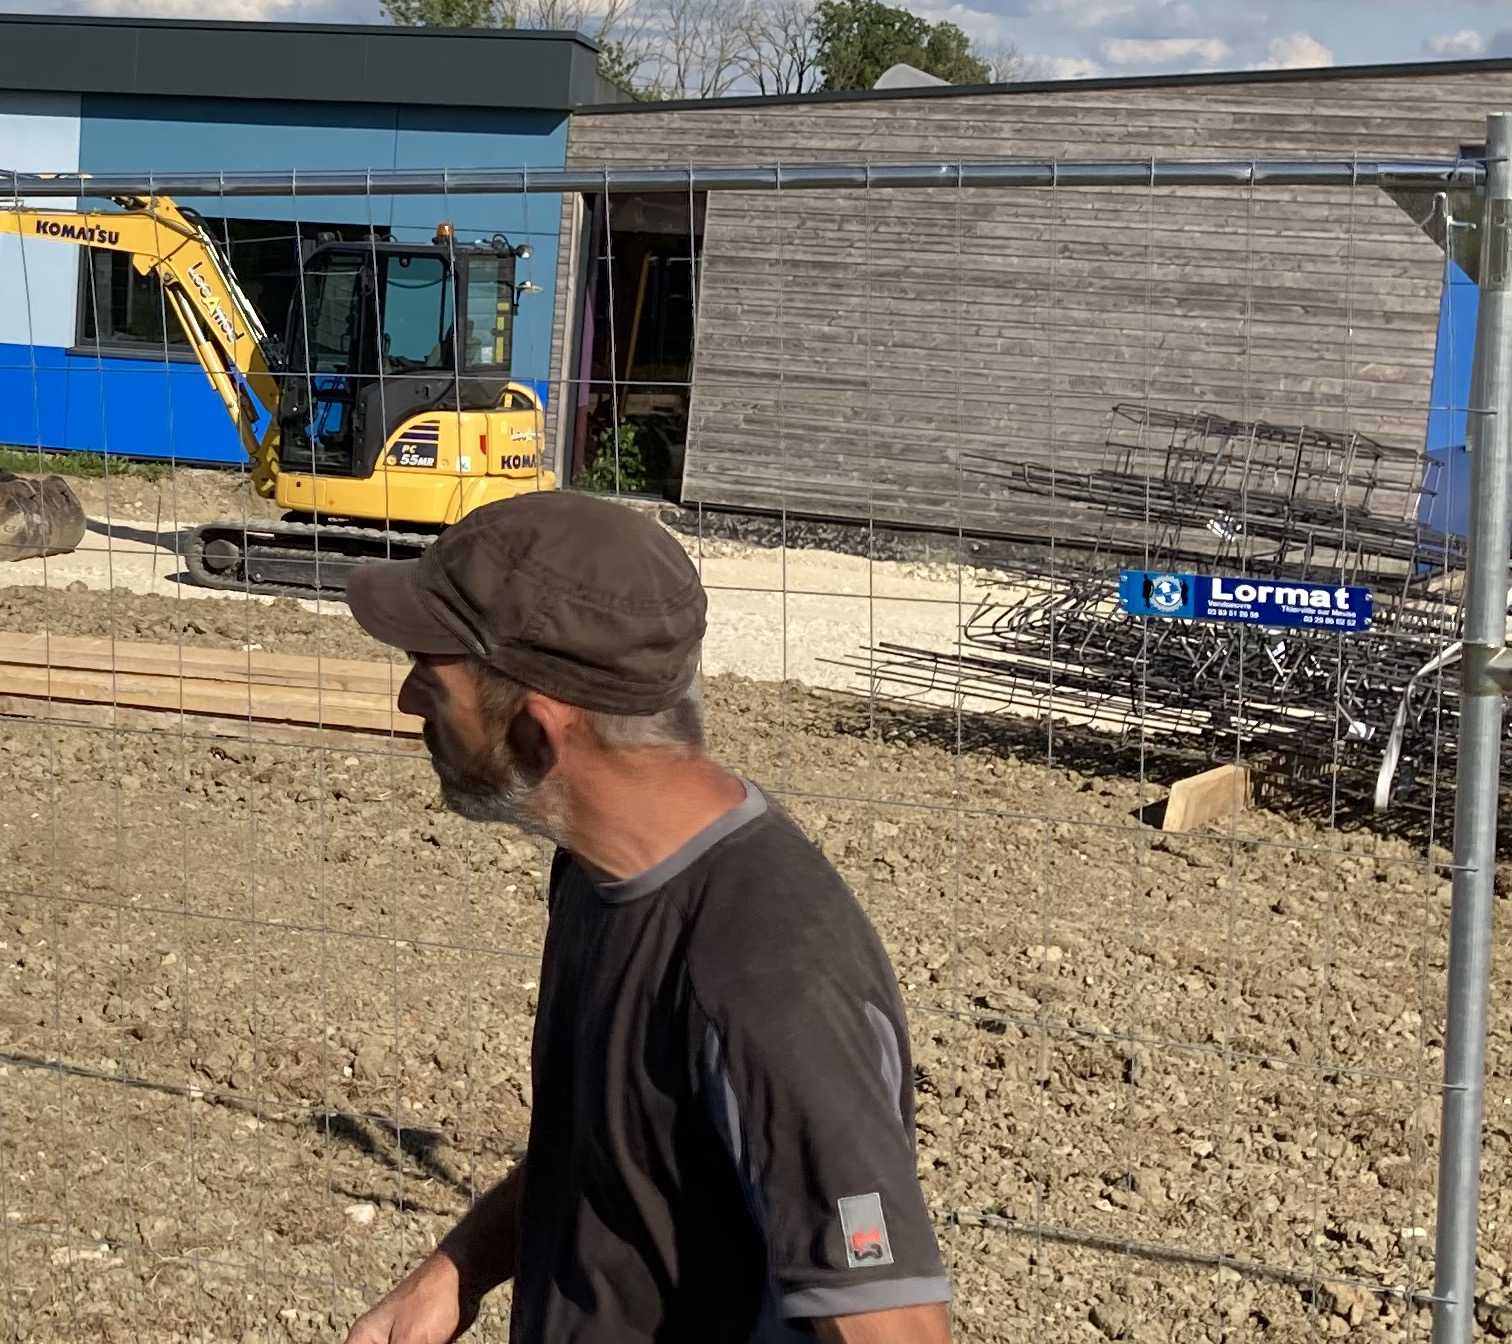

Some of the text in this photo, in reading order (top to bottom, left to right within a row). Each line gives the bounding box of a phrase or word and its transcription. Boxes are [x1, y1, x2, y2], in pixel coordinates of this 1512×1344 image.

[36, 220, 120, 245] KOMATSU
[401, 444, 417, 454] PC
[400, 453, 435, 467] 55MR
[1211, 577, 1350, 610] Lormat
